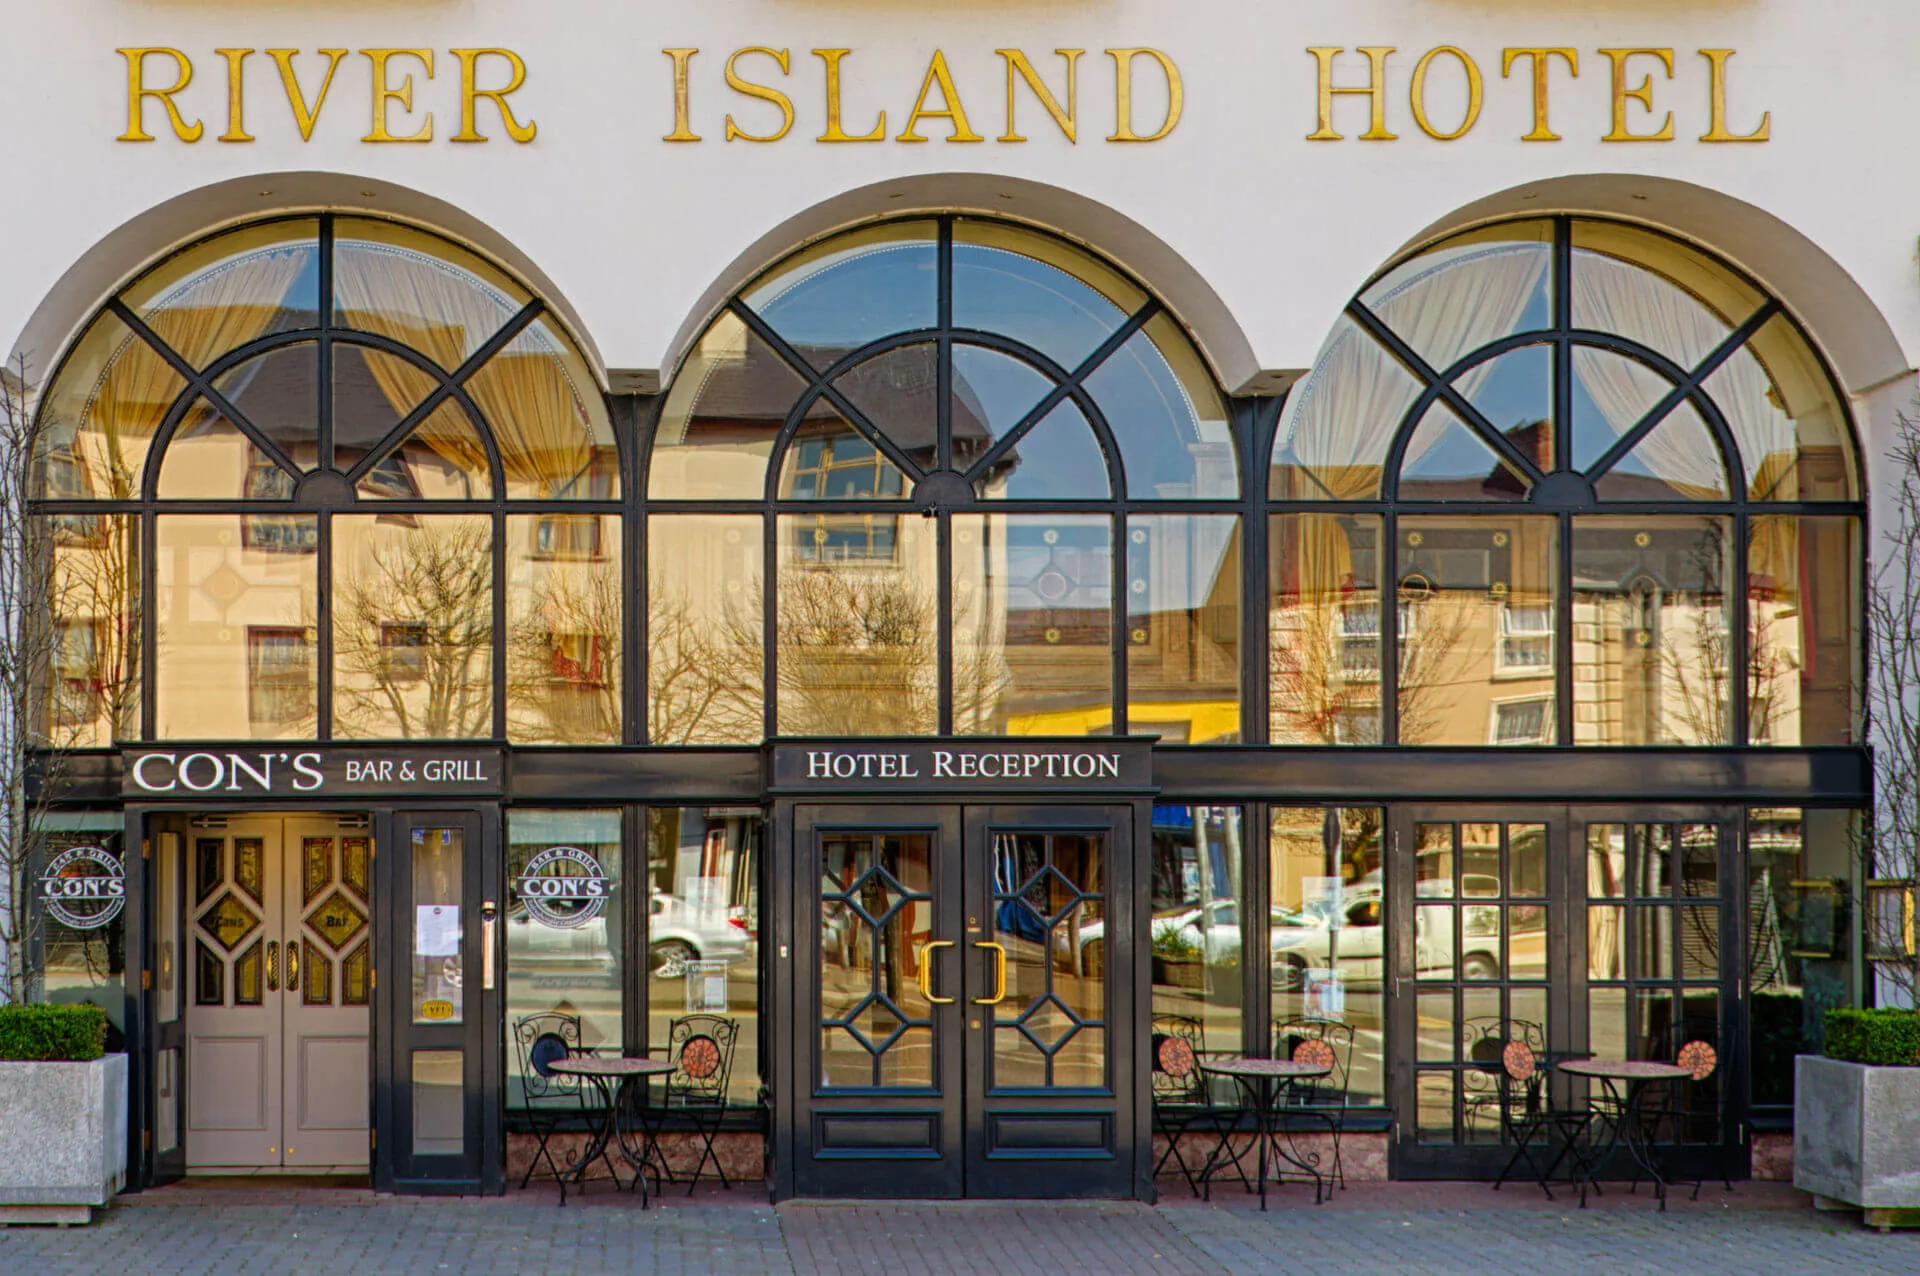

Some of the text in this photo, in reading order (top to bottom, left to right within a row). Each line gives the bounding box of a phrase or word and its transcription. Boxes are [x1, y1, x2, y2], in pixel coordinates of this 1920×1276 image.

[115, 44, 1771, 145] RIVER ISLAND HOTEL
[132, 752, 488, 791] CON'S BAR & GRILL
[806, 751, 1120, 778] HOTEL RECEPTION
[531, 853, 552, 871] BAR
[567, 850, 598, 873] GRILL
[44, 879, 125, 897] CON'S
[523, 879, 604, 896] CON'S
